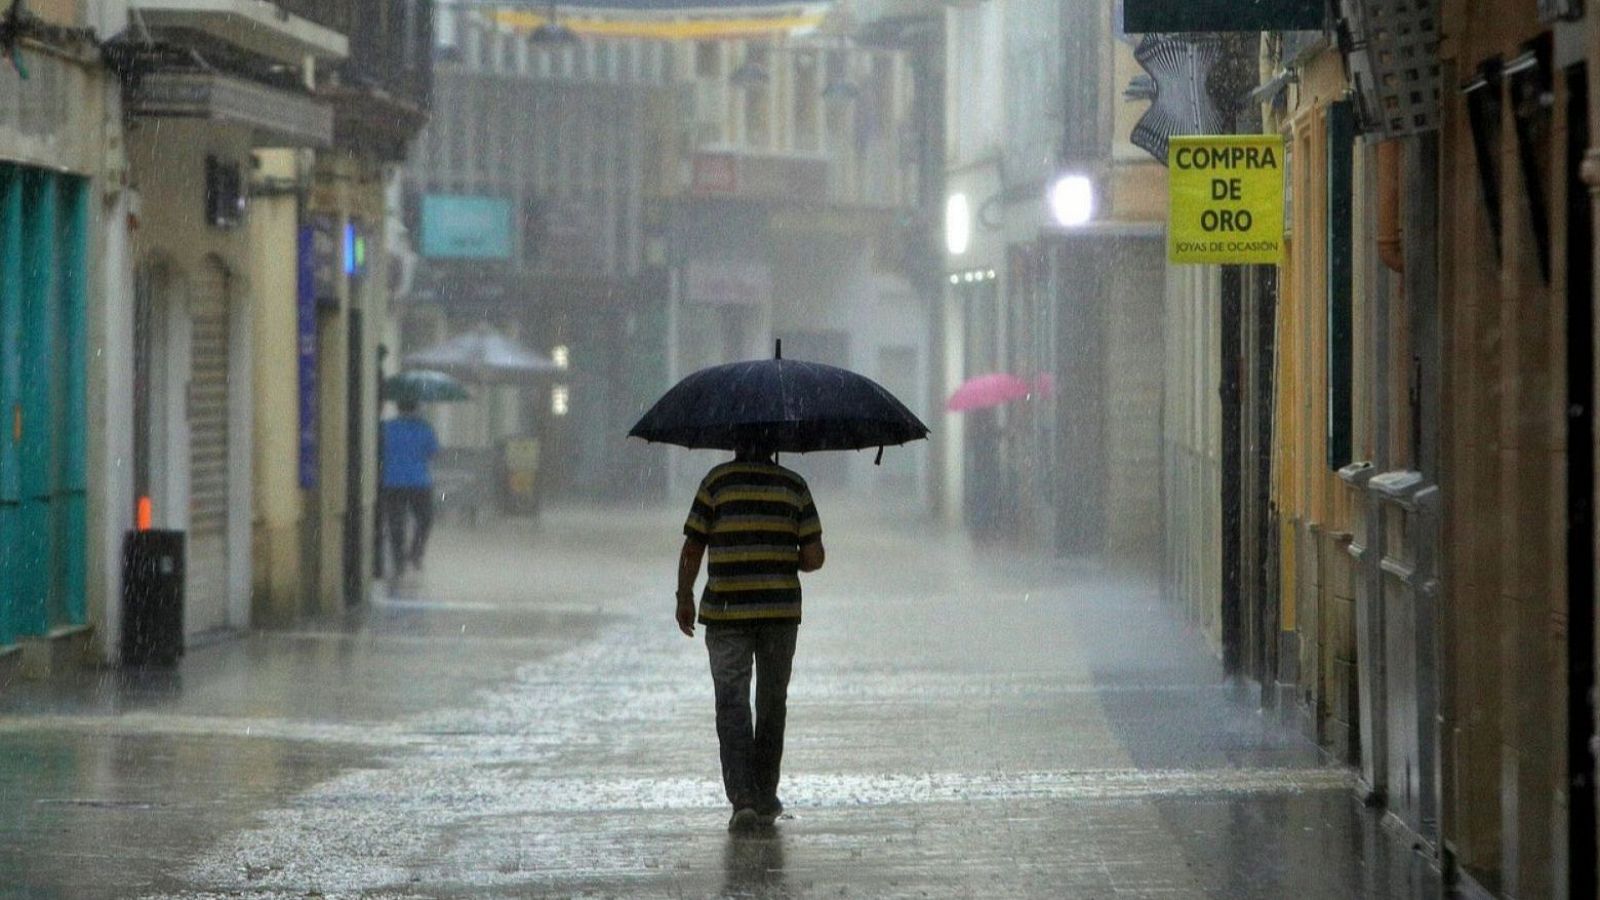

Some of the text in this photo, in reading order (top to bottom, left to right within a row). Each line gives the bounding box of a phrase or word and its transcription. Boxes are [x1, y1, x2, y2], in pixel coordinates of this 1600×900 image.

[1176, 147, 1277, 169] COMPRA
[1212, 178, 1242, 200] DE
[1201, 209, 1252, 232] ORO
[1175, 241, 1207, 254] JOYAS
[1209, 242, 1225, 251] DE
